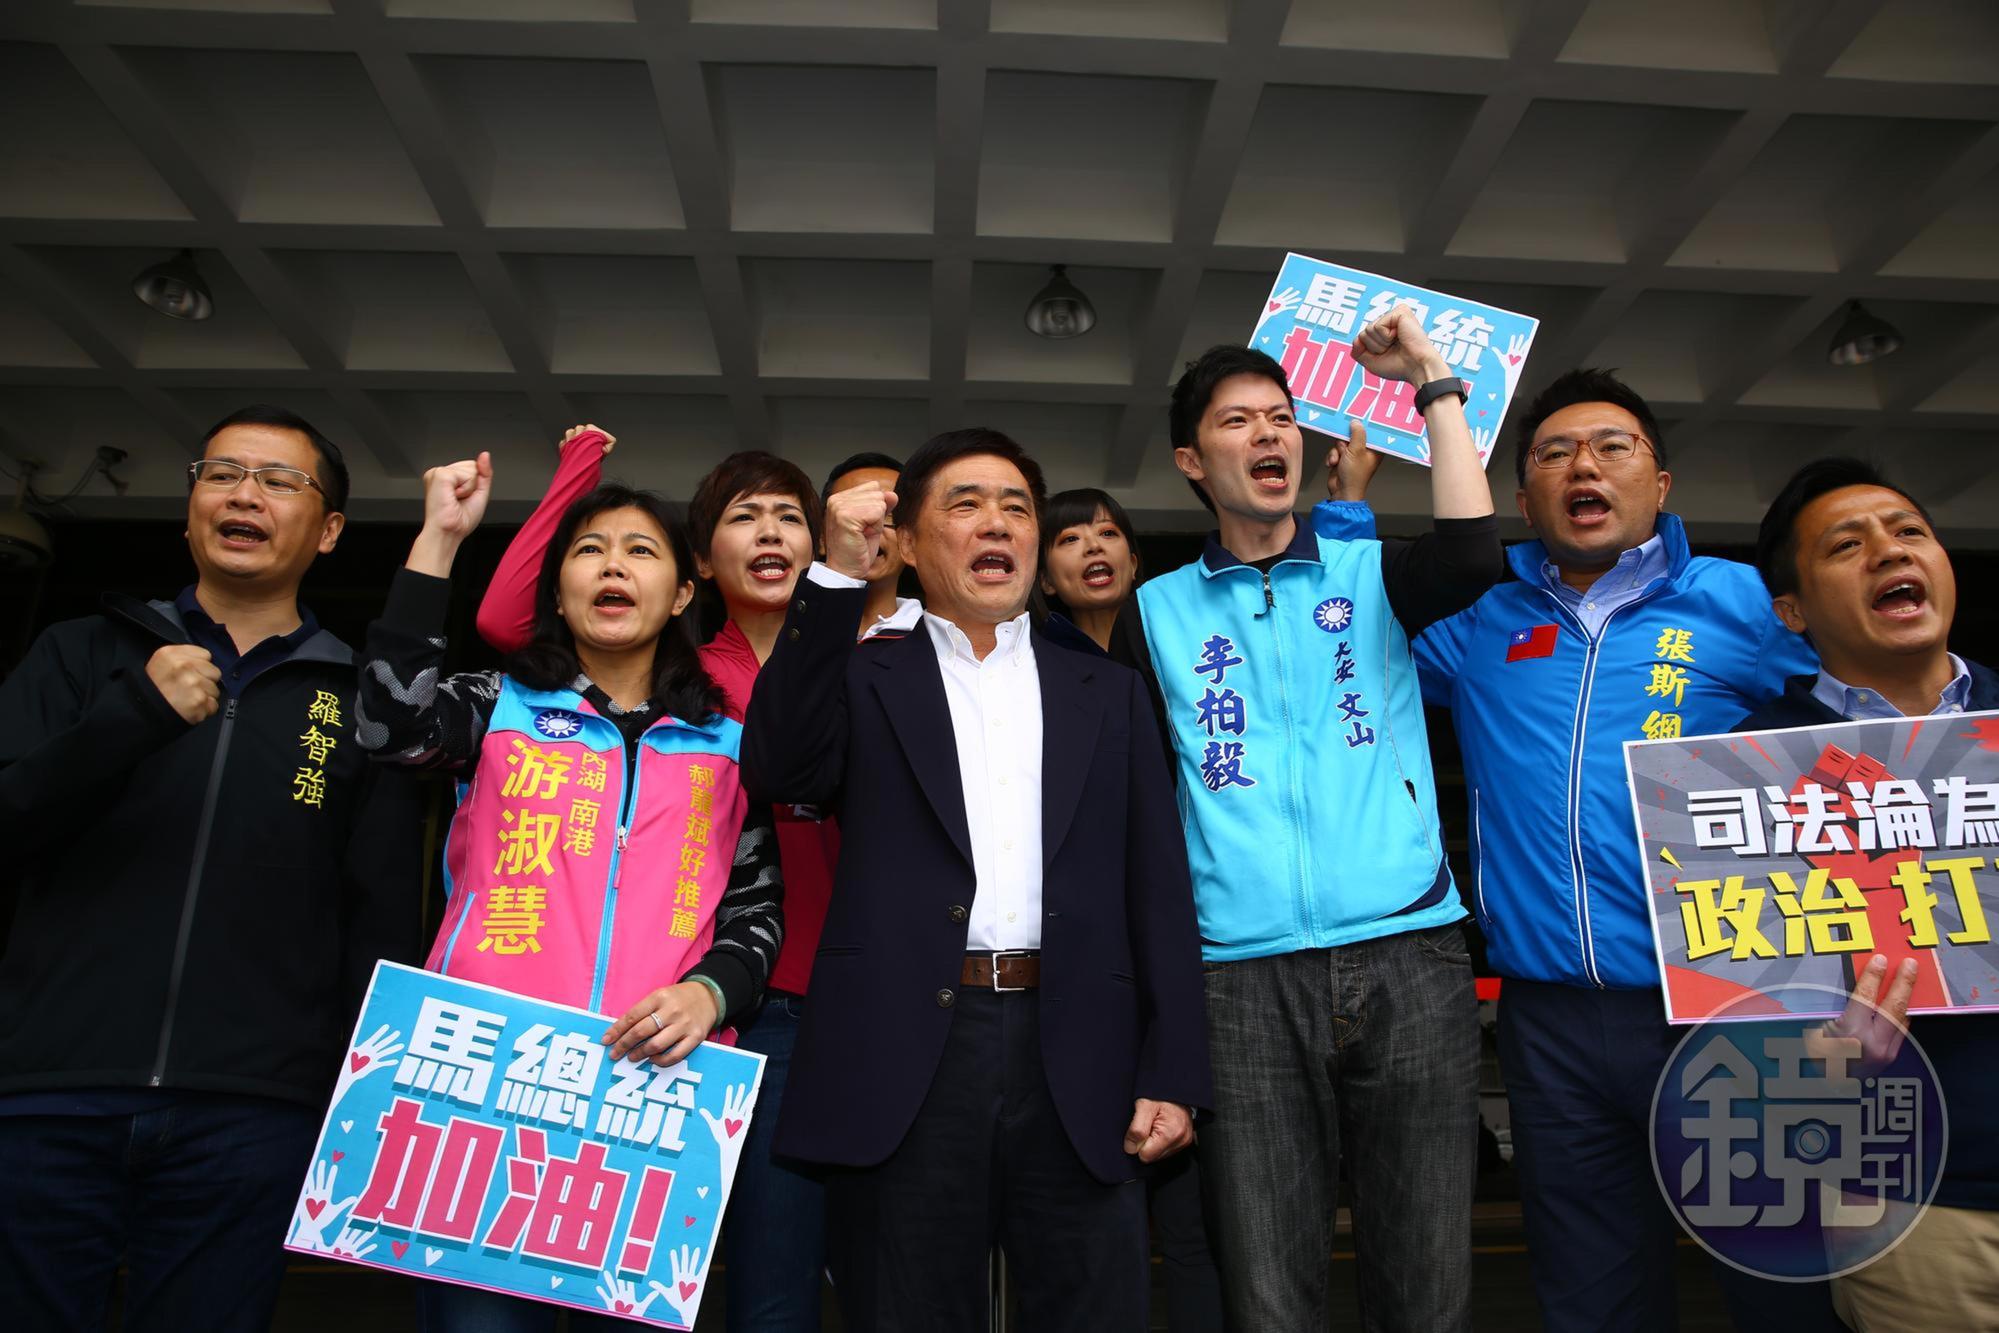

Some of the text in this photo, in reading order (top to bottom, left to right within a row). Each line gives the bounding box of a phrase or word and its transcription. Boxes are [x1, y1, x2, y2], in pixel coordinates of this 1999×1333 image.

[1193, 634, 1257, 792] 李柏毅
[1333, 641, 1375, 748] 大安 文山
[1641, 627, 1696, 740] 張斯網
[293, 689, 343, 809] 羅智強
[476, 738, 573, 955] 游淑慧
[561, 798, 602, 857] 南港
[668, 763, 716, 941] 郝龍斌好推薦
[1687, 776, 1999, 856] 司法淪為
[1675, 857, 1999, 961] 政治打
[393, 996, 703, 1155] 馬總統
[347, 1095, 677, 1280] 加油!
